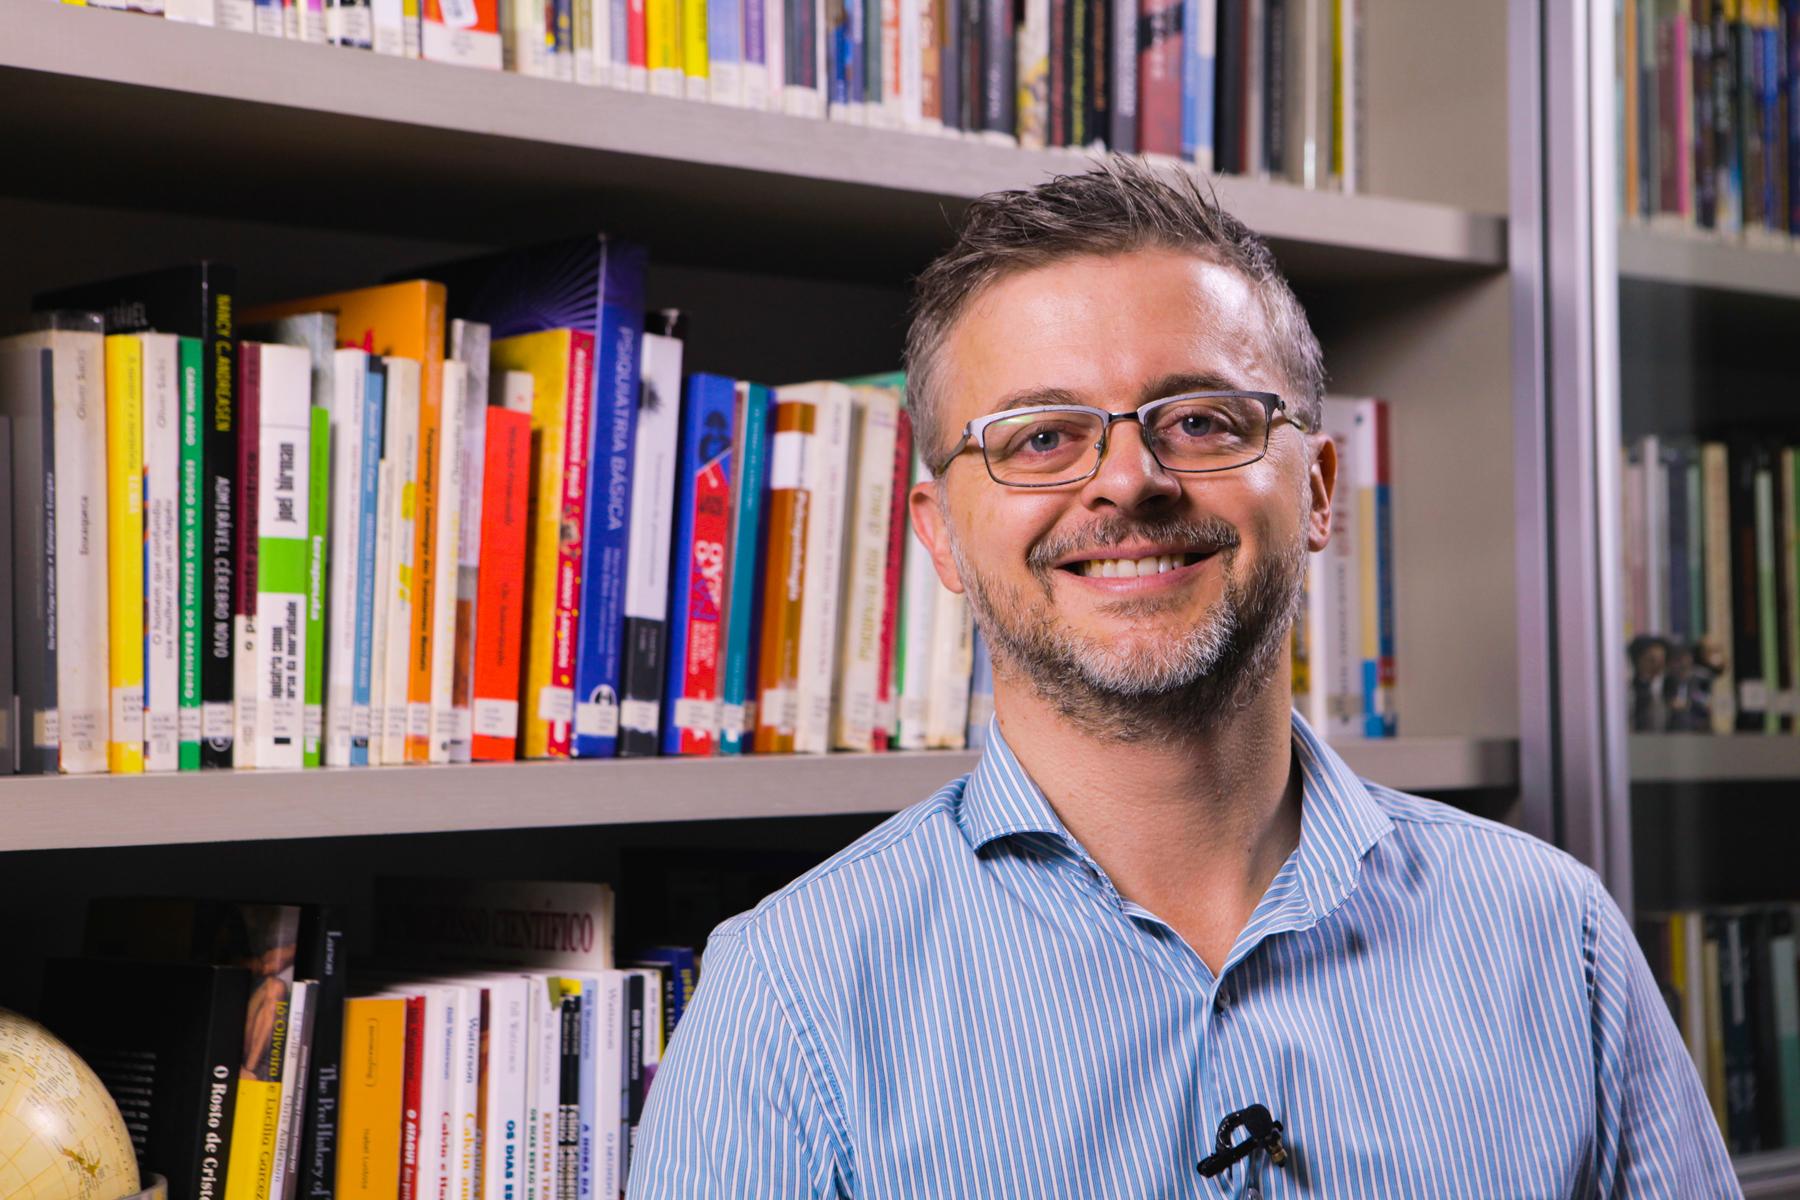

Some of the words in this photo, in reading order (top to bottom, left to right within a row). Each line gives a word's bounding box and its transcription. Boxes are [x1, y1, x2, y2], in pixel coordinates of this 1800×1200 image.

[216, 294, 232, 337] NANCY
[612, 326, 634, 452] PSIQUIATRIA
[185, 459, 196, 505] ESTUDO
[275, 442, 295, 491] birman
[275, 498, 297, 523] joel
[608, 456, 627, 530] BÁSICA
[186, 509, 195, 525] DA
[214, 476, 233, 554] ADMIRÁVEL
[185, 529, 195, 558] VIDA
[185, 562, 195, 605] SEXUAL
[213, 557, 232, 619] CÉREBRO
[244, 559, 255, 634] paciente
[310, 535, 323, 621] terapeuta
[562, 566, 574, 609] JENNY
[152, 585, 162, 630] homem
[163, 595, 174, 635] mulher
[185, 609, 194, 628] DO
[286, 601, 296, 656] moralidade
[212, 622, 230, 658] NOVO
[245, 641, 253, 650] o
[272, 627, 282, 652] como
[559, 611, 571, 668] LAWSON
[184, 631, 194, 698] BRASILEIRO
[271, 656, 283, 698] iquiatria
[287, 660, 296, 670] da
[493, 897, 593, 953] CIENTÍFICO
[325, 931, 342, 975] Larson
[585, 989, 593, 1006] Bill
[607, 988, 616, 1050] Watterson
[632, 1009, 641, 1028] Bill
[269, 1020, 287, 1077] Oliveira
[444, 1027, 453, 1080] Watterson
[466, 1018, 477, 1084] Watterson
[584, 1009, 592, 1060] Watterson
[631, 1029, 640, 1080] Watterson
[213, 1065, 229, 1079] O
[268, 1085, 276, 1093] e
[319, 1064, 337, 1095] The
[207, 1083, 227, 1128] Rosto
[407, 1109, 417, 1118] O
[529, 1108, 537, 1121] OS
[205, 1132, 221, 1153] de
[405, 1121, 416, 1165] ATAQUE
[440, 1112, 451, 1158] Calvin
[462, 1113, 475, 1170] Calvin
[506, 1120, 515, 1140] OS
[529, 1124, 537, 1148] DIAS
[542, 1112, 552, 1172] EXISTEM
[583, 1124, 590, 1132] A
[260, 1150, 271, 1199] Garcez
[274, 1127, 290, 1184] Anderson
[505, 1145, 515, 1179] DIAS
[311, 1181, 330, 1196] of
[582, 1178, 589, 1195] DA
